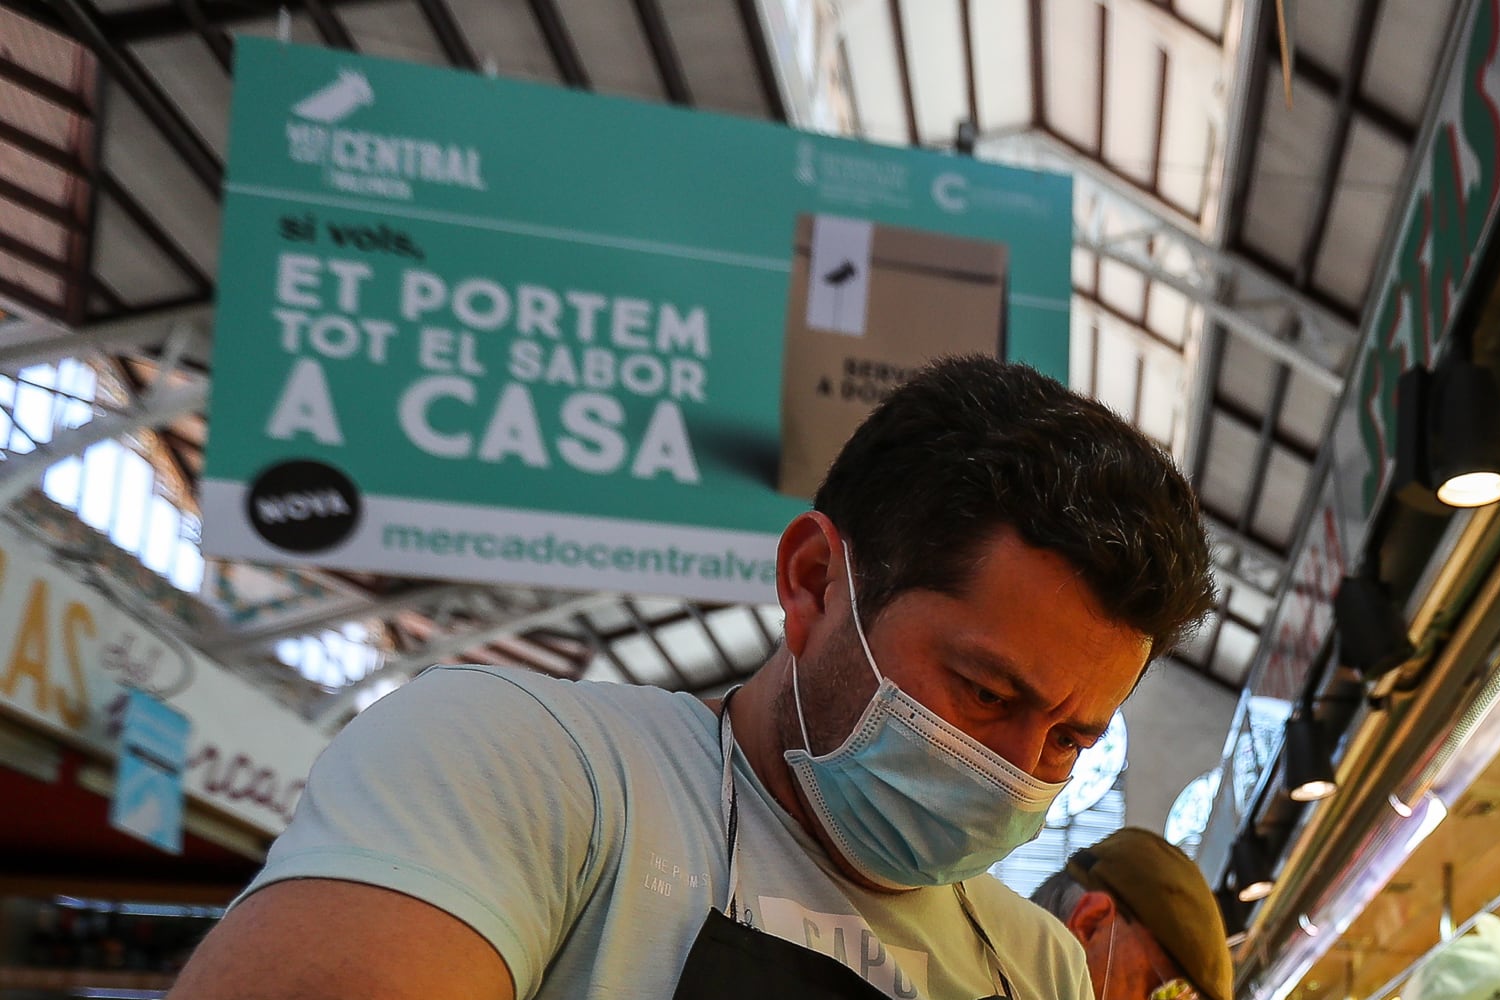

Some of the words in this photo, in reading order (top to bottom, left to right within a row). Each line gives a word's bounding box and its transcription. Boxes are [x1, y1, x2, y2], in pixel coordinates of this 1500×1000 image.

[273, 308, 397, 364] TOT
[419, 327, 485, 376] EL
[508, 339, 707, 404] SABOR
[276, 252, 373, 313] ET
[403, 268, 710, 360] PORTEM
[266, 356, 344, 447] A
[398, 374, 701, 485] CASA
[257, 488, 351, 525] NOVA
[0, 545, 98, 730] AS
[644, 873, 672, 897] LAND
